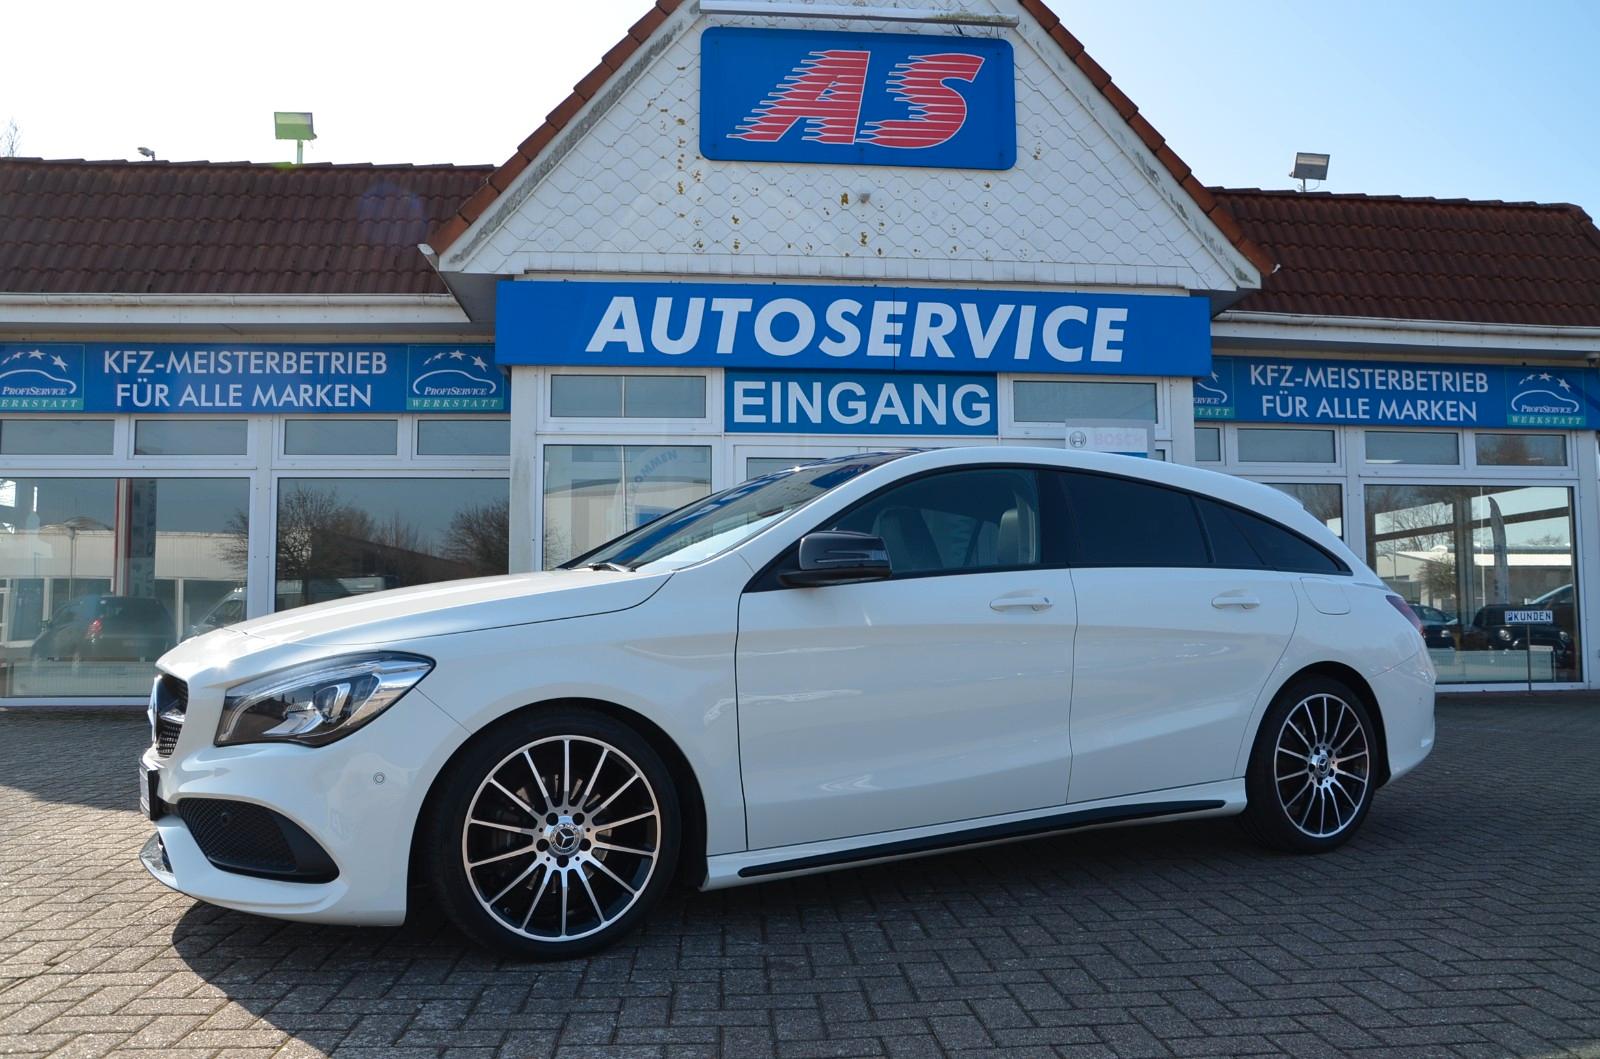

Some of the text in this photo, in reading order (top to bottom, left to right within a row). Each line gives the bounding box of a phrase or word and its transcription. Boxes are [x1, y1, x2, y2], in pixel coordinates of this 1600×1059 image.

[726, 49, 986, 149] AS
[585, 296, 1129, 363] AUTOSERVICE
[103, 350, 388, 375] KFZ-MEISTERBETRIEB
[116, 377, 372, 408] FÜR ALLE MARKEN
[1250, 364, 1489, 393] KFZ-MEISTERBETRIEB
[0, 399, 77, 408] ERKSTATT
[412, 399, 498, 408] WERKSTATT
[734, 380, 992, 427] EINGANG
[1262, 390, 1477, 422] FÜR ALLE MARKEN
[1512, 415, 1582, 425] WERKSTATT
[1514, 611, 1551, 621] KUNDEN
